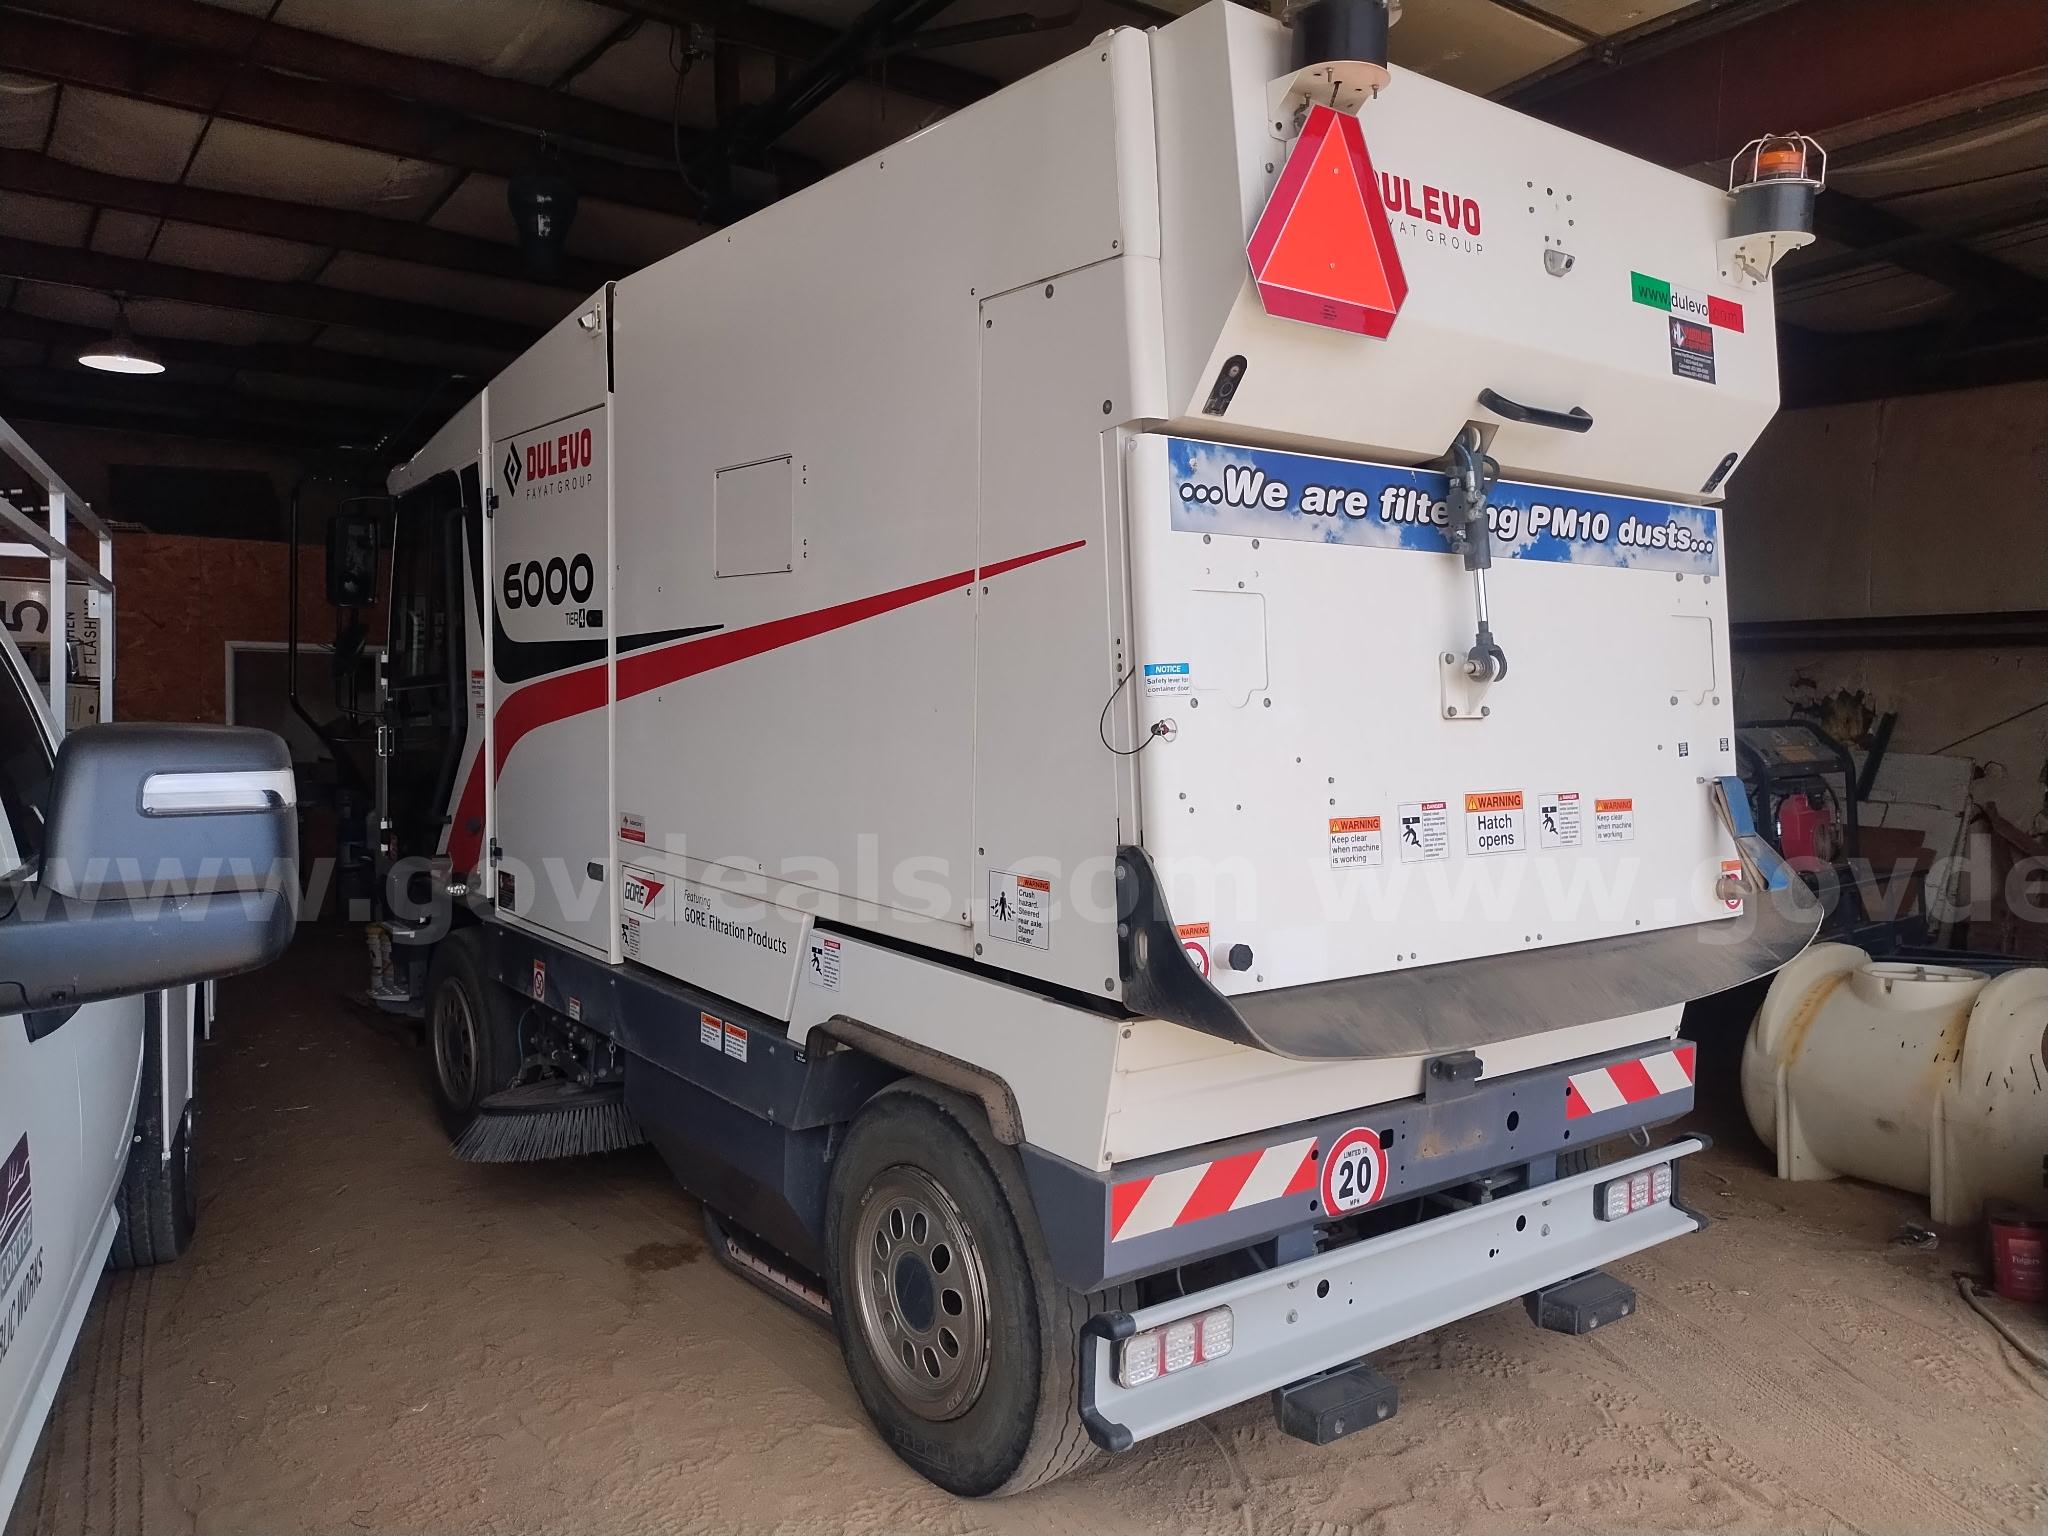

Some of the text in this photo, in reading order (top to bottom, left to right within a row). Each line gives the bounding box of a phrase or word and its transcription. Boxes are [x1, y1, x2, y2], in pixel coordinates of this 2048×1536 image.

[1374, 169, 1480, 236] ULEVO
[1388, 218, 1483, 254] YAT GROUP
[1638, 285, 1738, 321] www.dulevocom
[527, 428, 592, 481] DULEVO
[526, 474, 592, 500] FAYAT GROUP
[1301, 484, 1368, 519] are
[1380, 485, 1520, 542] filteng
[1528, 505, 1610, 542] PM10
[503, 553, 594, 610] 6000
[1155, 665, 1182, 673] NOTICE
[1147, 677, 1167, 685] Safety
[1477, 795, 1521, 808] WARNING
[1603, 801, 1632, 810] WARNING
[1341, 819, 1379, 830] WARNING
[1477, 813, 1512, 830] Hatch
[1332, 835, 1349, 844] Keep
[1478, 833, 1514, 850] opens
[1603, 831, 1622, 839] working
[1352, 844, 1380, 852] machine
[1332, 854, 1367, 864] is working
[1023, 880, 1048, 890] WARNING
[624, 881, 646, 905] GORE
[684, 889, 711, 910] Featuring
[1019, 889, 1036, 899] Crush
[1019, 907, 1040, 918] Steered
[1018, 917, 1029, 925] rear
[709, 914, 745, 941] Filtration
[747, 926, 787, 954] Products
[1018, 925, 1034, 935] Stand
[1180, 926, 1209, 936] WARNING
[1343, 1146, 1368, 1159] LIMITED TO
[1338, 1156, 1372, 1199] 20
[17, 1245, 43, 1327] WORKS
